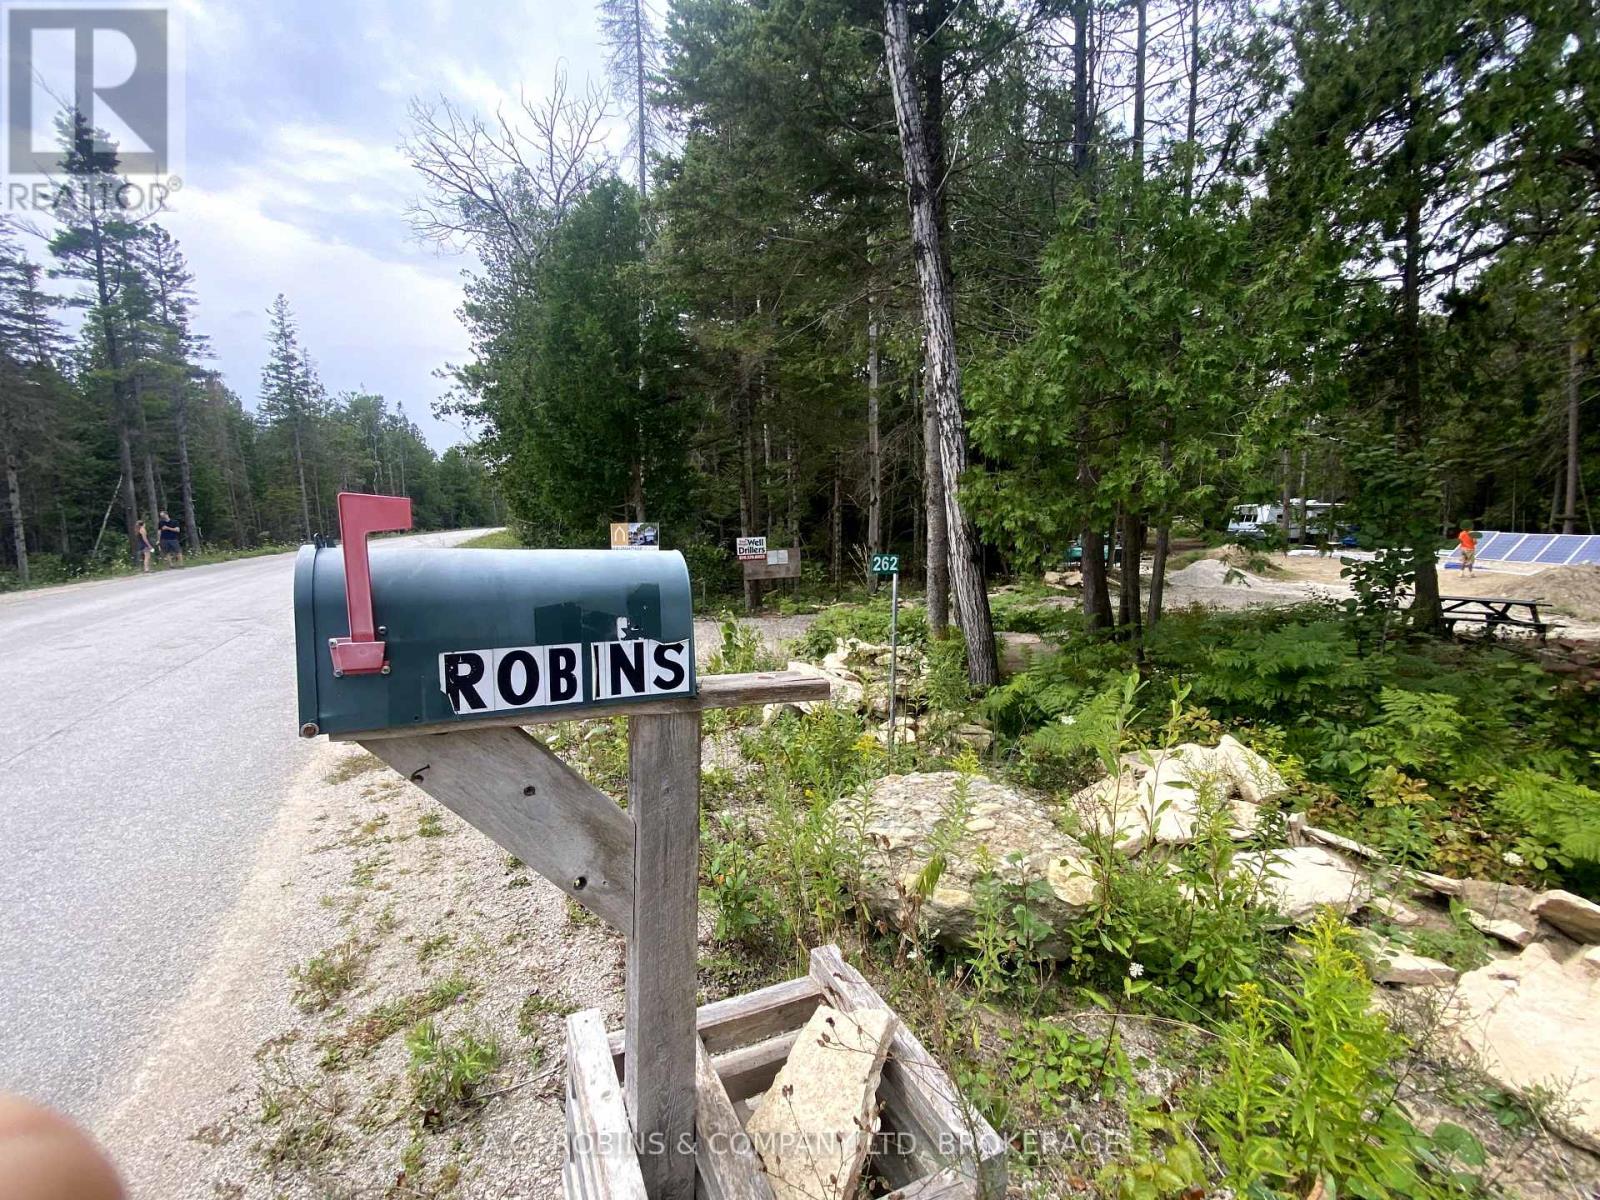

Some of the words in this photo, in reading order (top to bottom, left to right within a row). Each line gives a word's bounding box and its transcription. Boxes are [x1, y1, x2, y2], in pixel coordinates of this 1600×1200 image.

[745, 538, 764, 546] Well
[873, 556, 898, 571] 262
[444, 641, 685, 711] ROBINS
